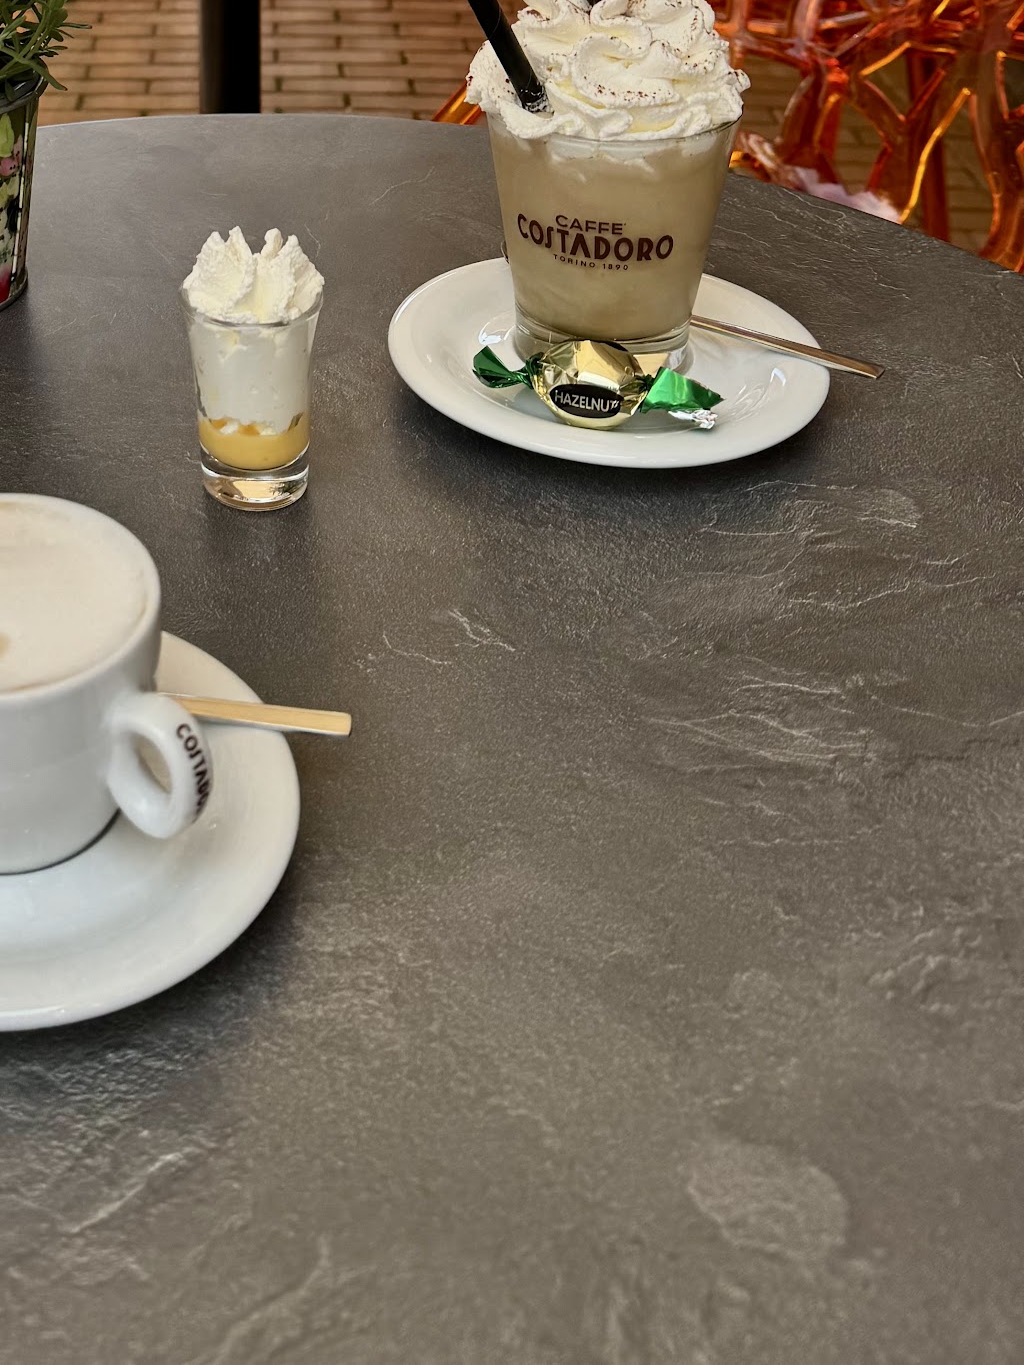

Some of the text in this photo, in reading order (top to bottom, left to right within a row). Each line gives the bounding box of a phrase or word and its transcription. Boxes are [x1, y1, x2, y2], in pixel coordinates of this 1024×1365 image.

[517, 213, 674, 262] COSTADORO
[553, 253, 629, 271] TORINO 1890
